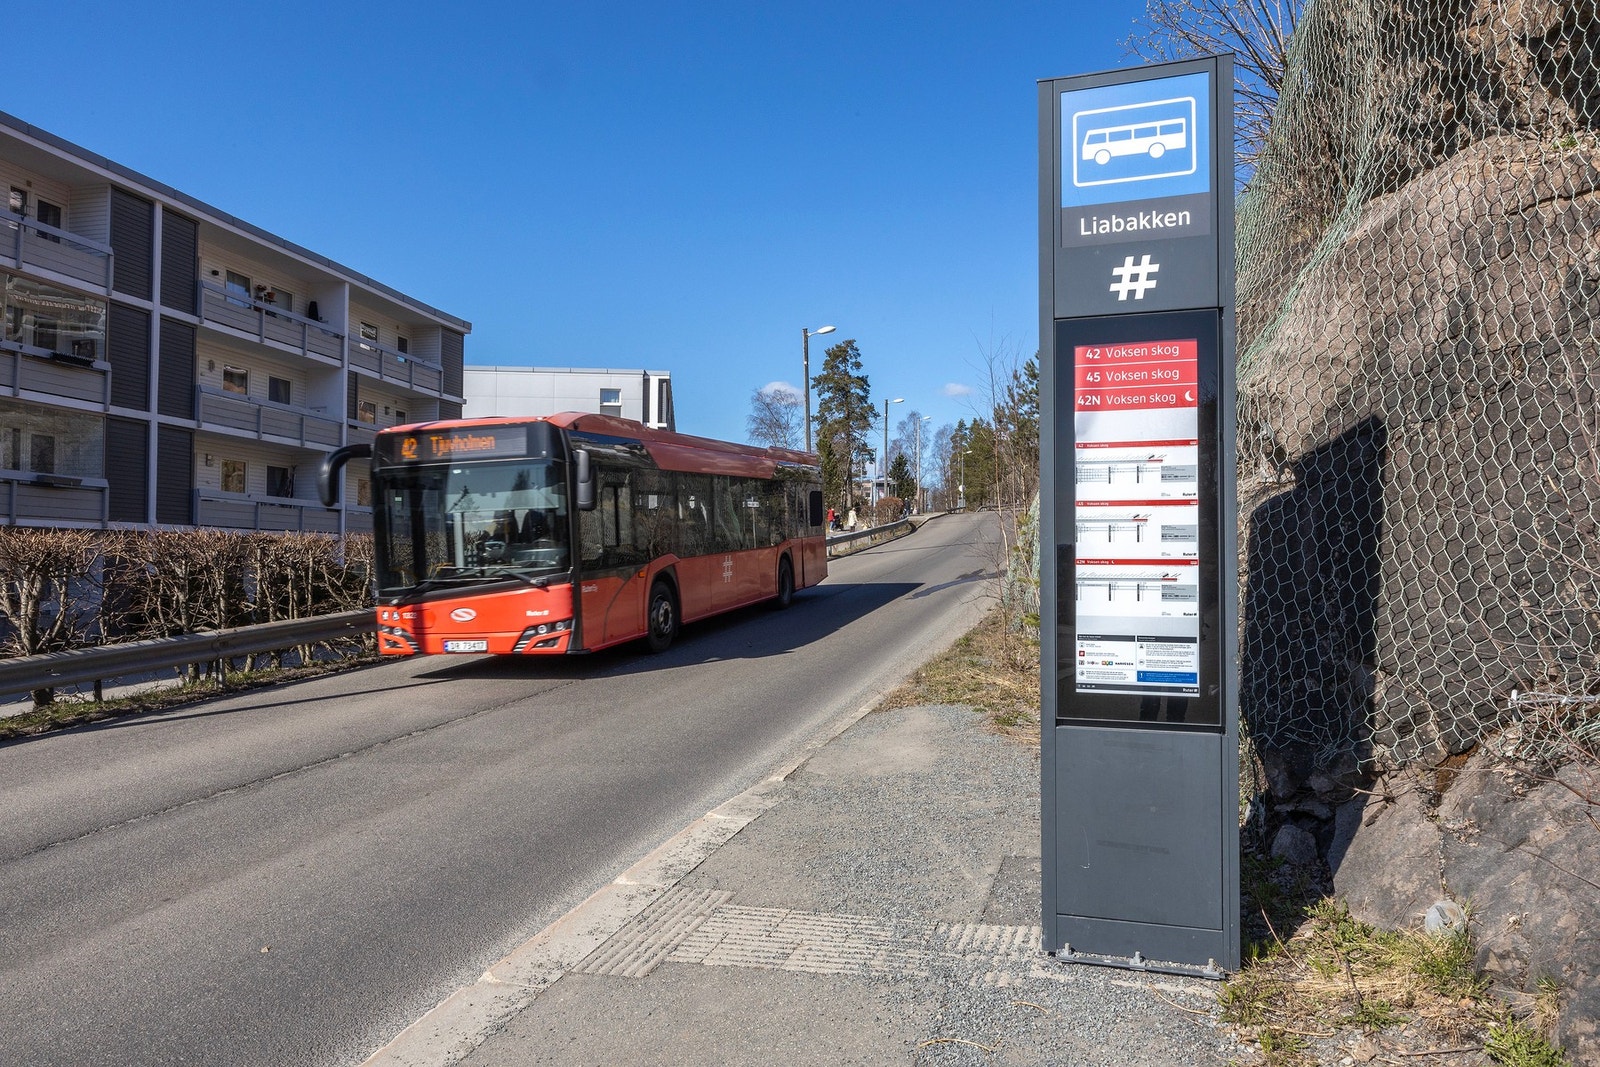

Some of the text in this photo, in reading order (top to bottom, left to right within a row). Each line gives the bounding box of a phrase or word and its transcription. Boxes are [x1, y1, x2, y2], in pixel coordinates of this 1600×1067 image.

[1080, 210, 1191, 236] Liabakken
[1085, 345, 1180, 359] 42 Voksen skog
[1086, 369, 1180, 382] 45 Voksen skog
[1077, 393, 1176, 406] 42N Voksen skog
[401, 437, 418, 459] 42
